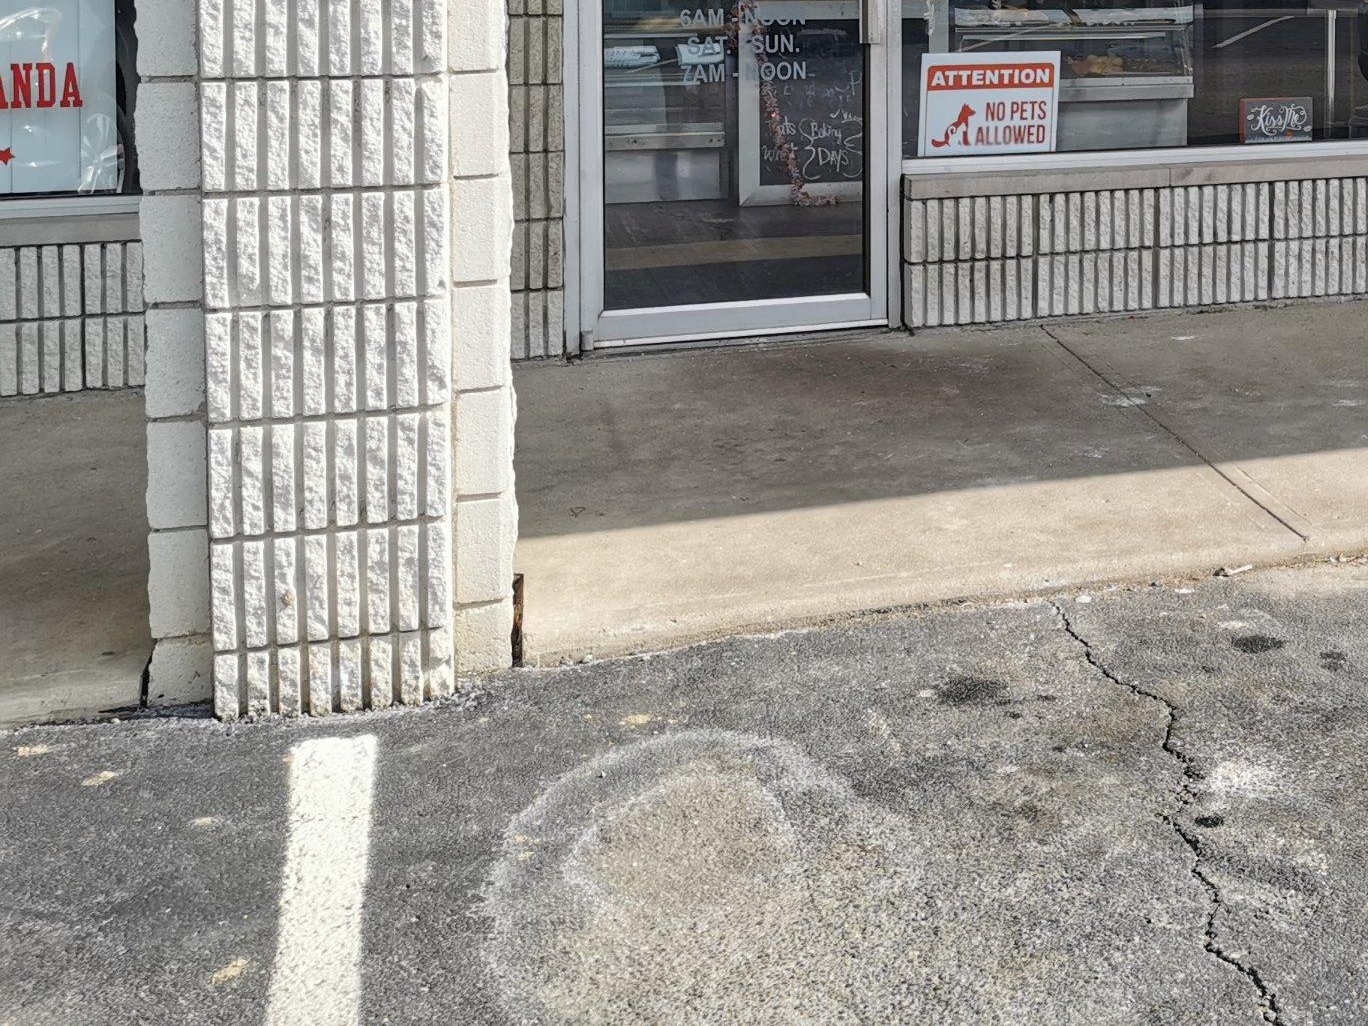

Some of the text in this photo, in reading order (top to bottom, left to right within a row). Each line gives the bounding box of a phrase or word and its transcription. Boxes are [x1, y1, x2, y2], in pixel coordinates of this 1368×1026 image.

[680, 8, 725, 27] 6AM
[687, 34, 800, 55] SAT. SUN.
[680, 63, 725, 83] 7AM
[744, 61, 807, 81] OON
[931, 68, 1050, 87] ATTENTION
[985, 100, 1047, 122] NO PETS
[1251, 104, 1307, 136] Kiss Me
[974, 124, 1046, 146] ALLOWED
[817, 147, 849, 172] DAYS
